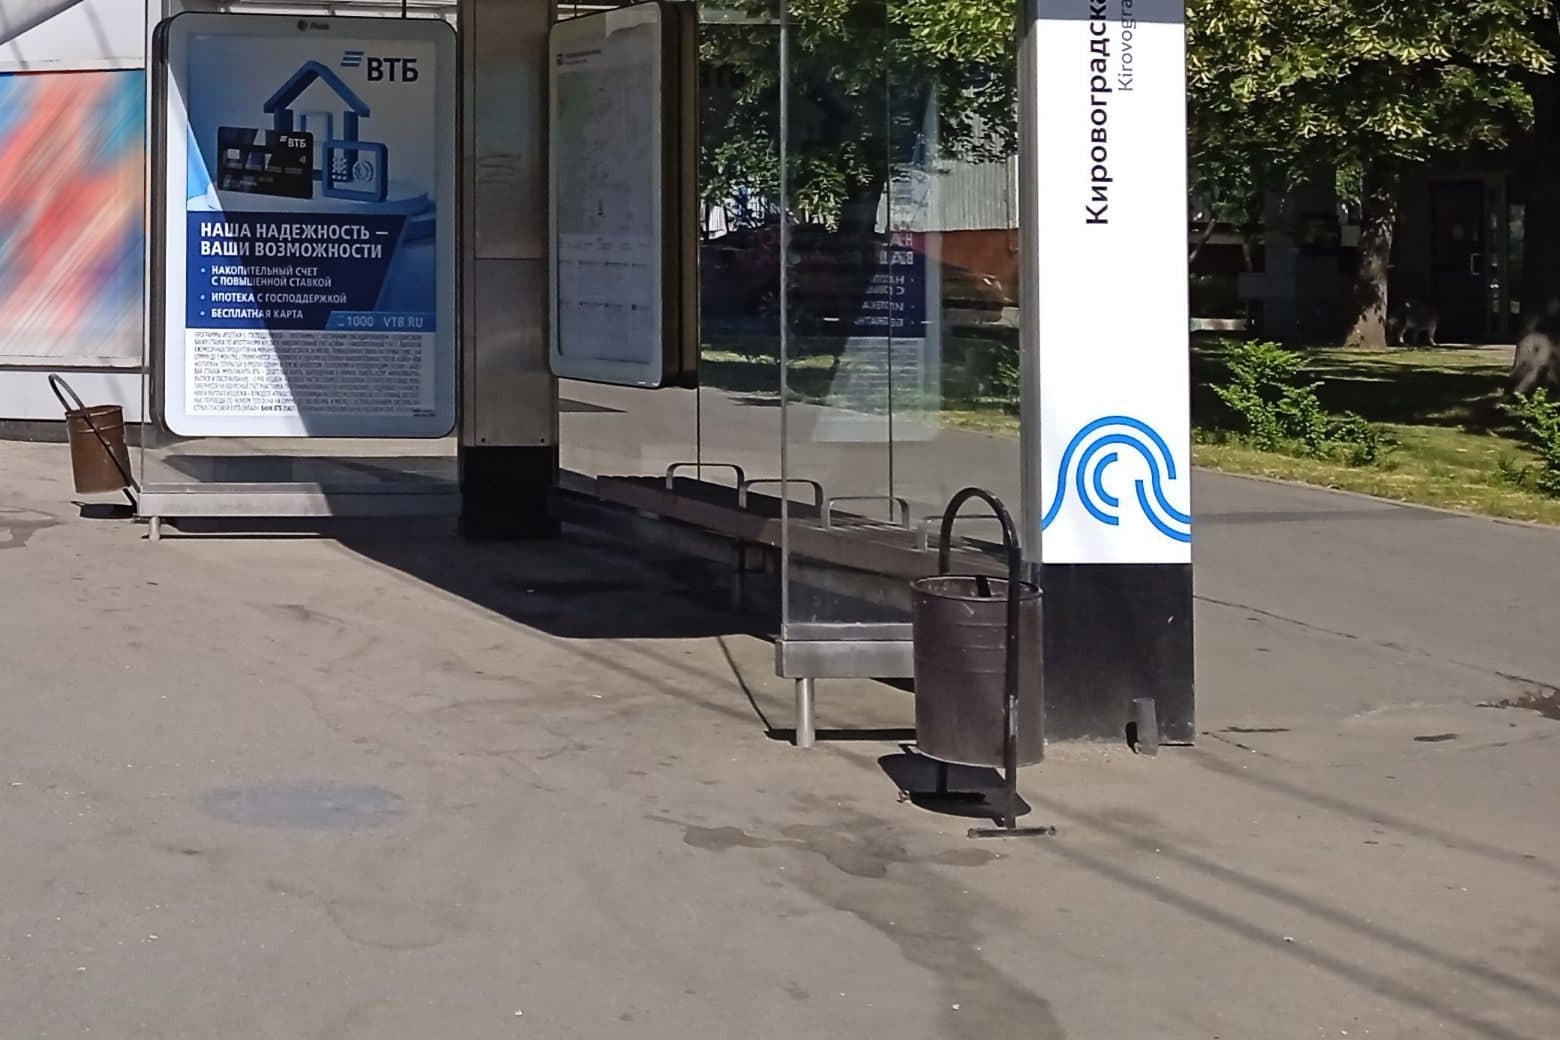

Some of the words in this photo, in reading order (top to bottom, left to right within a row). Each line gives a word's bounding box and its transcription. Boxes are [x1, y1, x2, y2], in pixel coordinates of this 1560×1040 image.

[367, 57, 419, 82] ВТБ
[288, 139, 306, 148] ВТБ
[201, 223, 251, 238] НАША
[256, 224, 370, 241] НАДЕЖНОСТЬ
[200, 241, 250, 256] ВАШИ
[255, 242, 382, 259] ВОЗМОЖНОСТИ
[211, 264, 293, 276] НАКОПИТЕЛЬНЫЙ
[295, 267, 318, 277] СЧЕТ
[211, 276, 219, 286] С
[220, 275, 287, 287] ПОВЫШЕННОЙ
[289, 275, 332, 288] СТАВКОЙ
[211, 293, 255, 302] ИПОТЕКА
[257, 293, 263, 302] С
[265, 292, 347, 304] ГОСПОДДЕРЖКОЙ
[211, 308, 271, 319] БЕСПЛАТНАЯ
[273, 309, 303, 319] КАРТА
[347, 315, 374, 327] 1000
